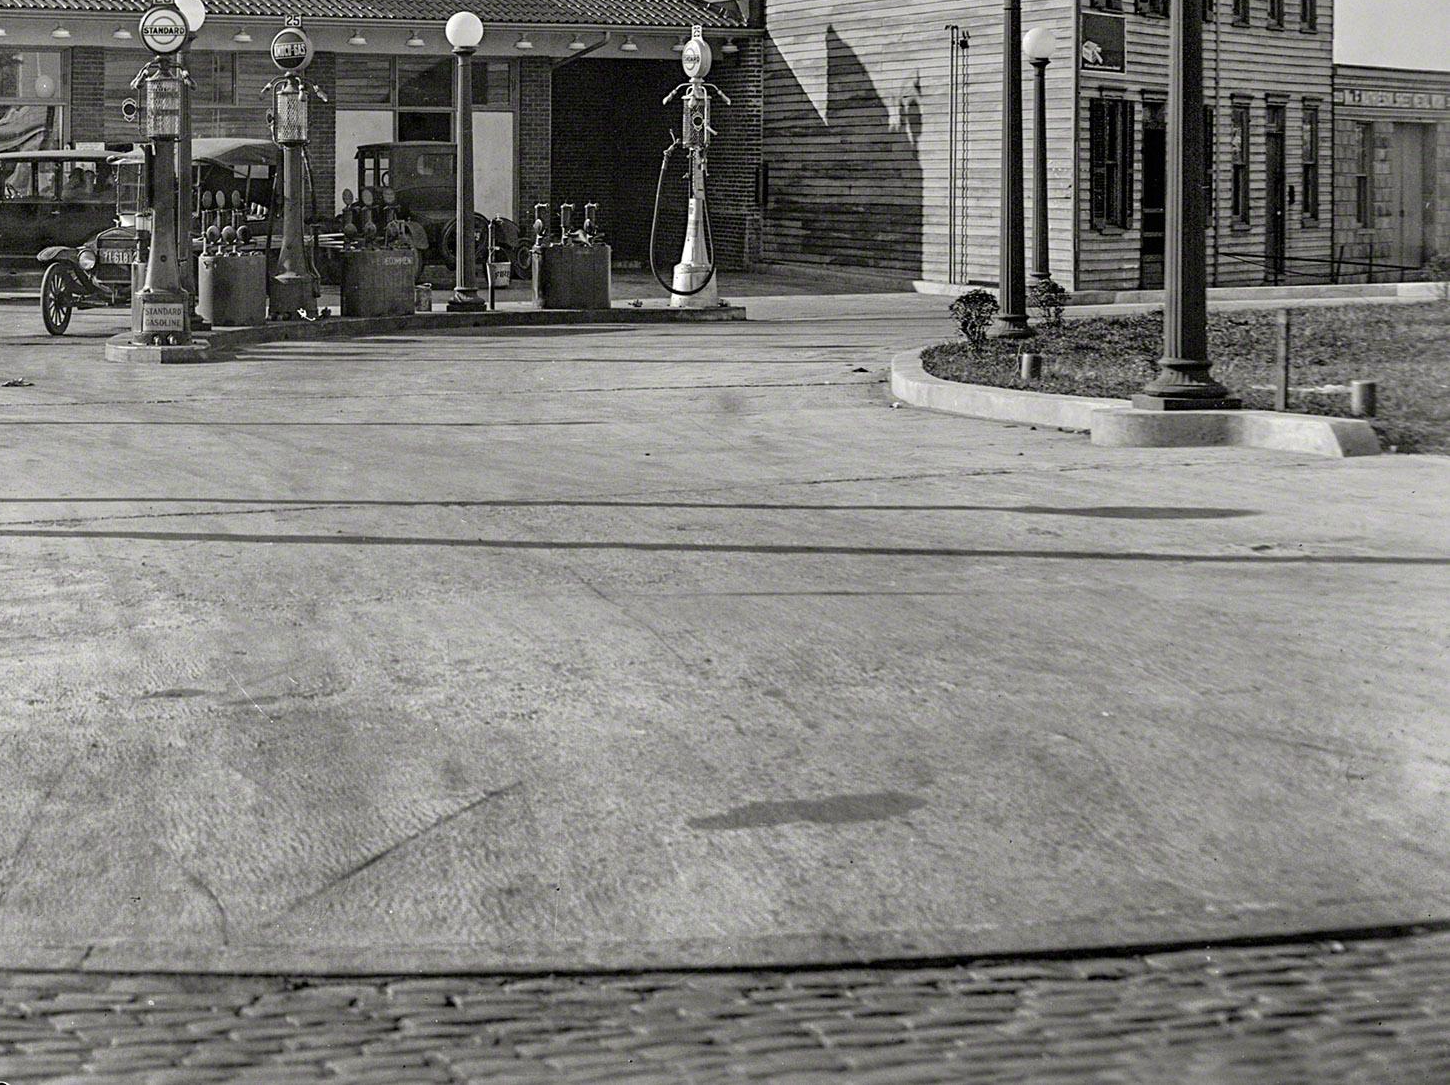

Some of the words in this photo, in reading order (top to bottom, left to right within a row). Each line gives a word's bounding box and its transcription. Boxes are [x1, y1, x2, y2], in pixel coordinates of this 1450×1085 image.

[286, 15, 300, 26] 25
[143, 26, 185, 35] STANDARD
[145, 307, 182, 315] STANDARD
[145, 318, 181, 326] GASOLINE
